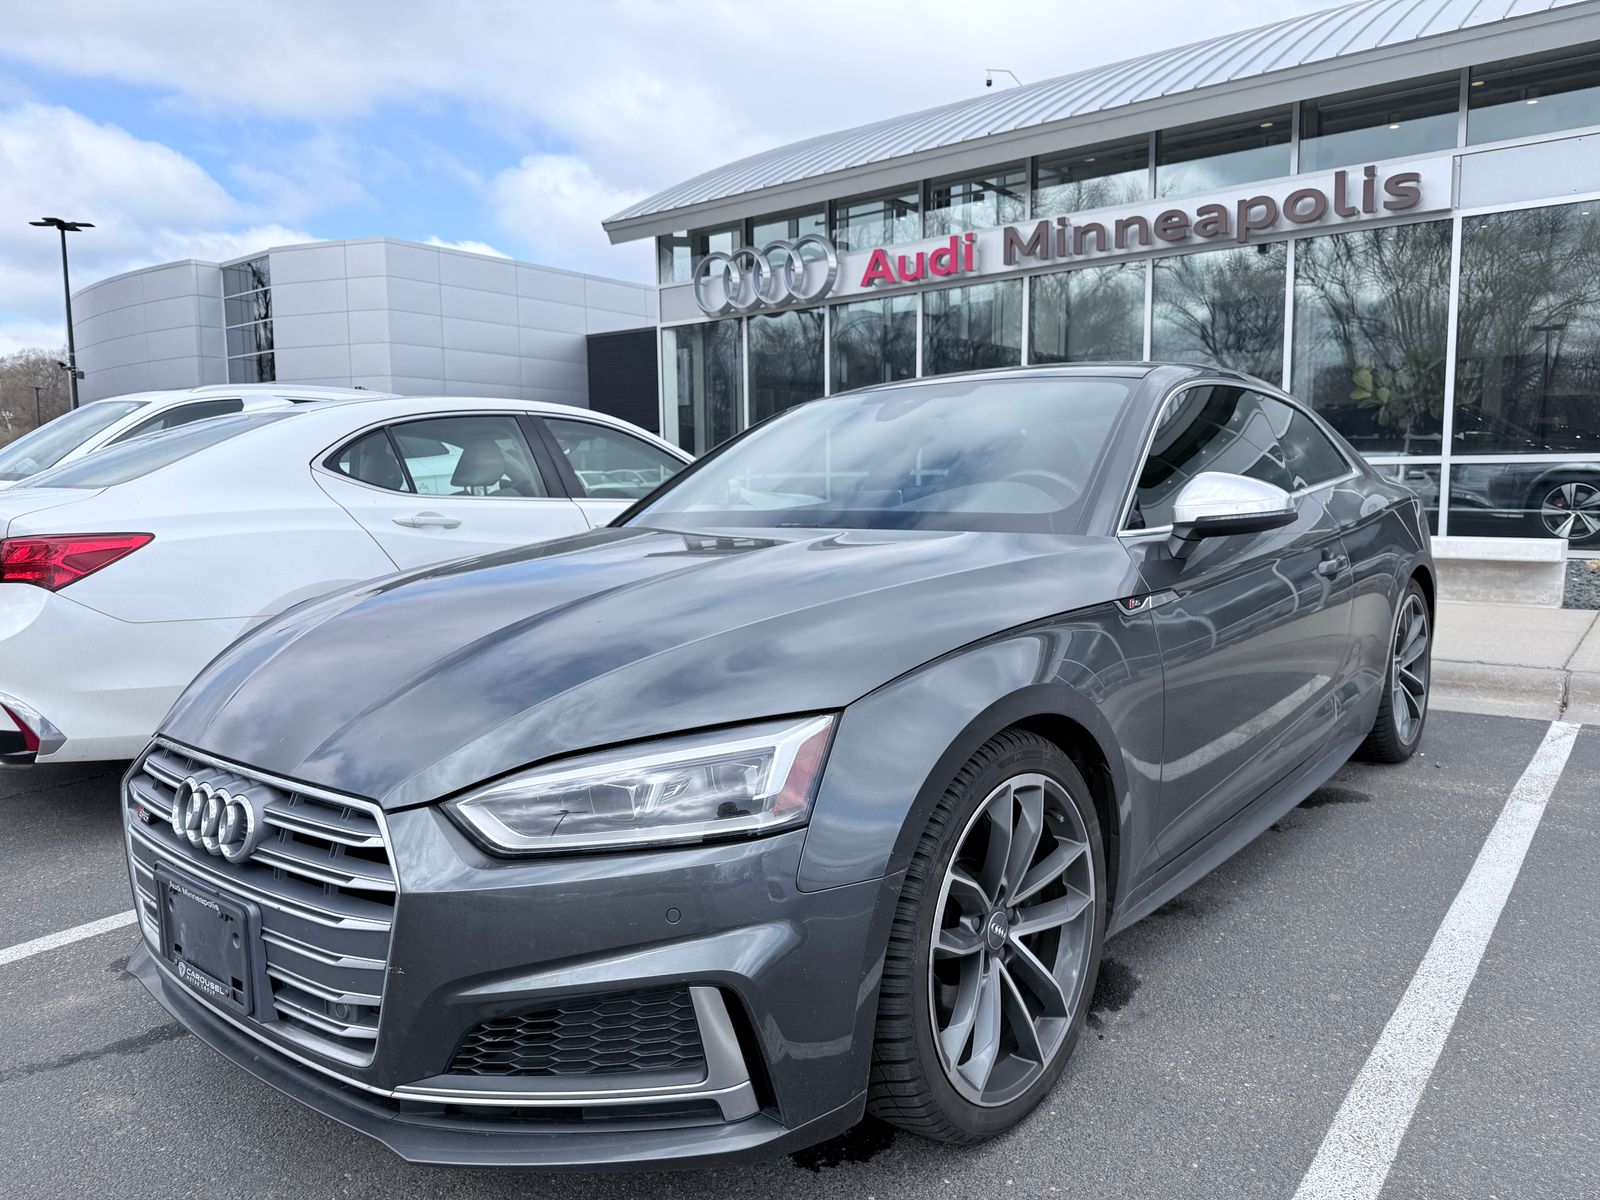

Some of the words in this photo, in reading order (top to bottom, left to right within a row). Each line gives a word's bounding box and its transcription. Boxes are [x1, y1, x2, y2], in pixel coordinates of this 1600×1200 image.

[860, 232, 974, 287] Audi
[1003, 165, 1422, 266] Minneapolis
[181, 886, 219, 911] Minneapolis
[186, 968, 224, 995] CAROUSEL
